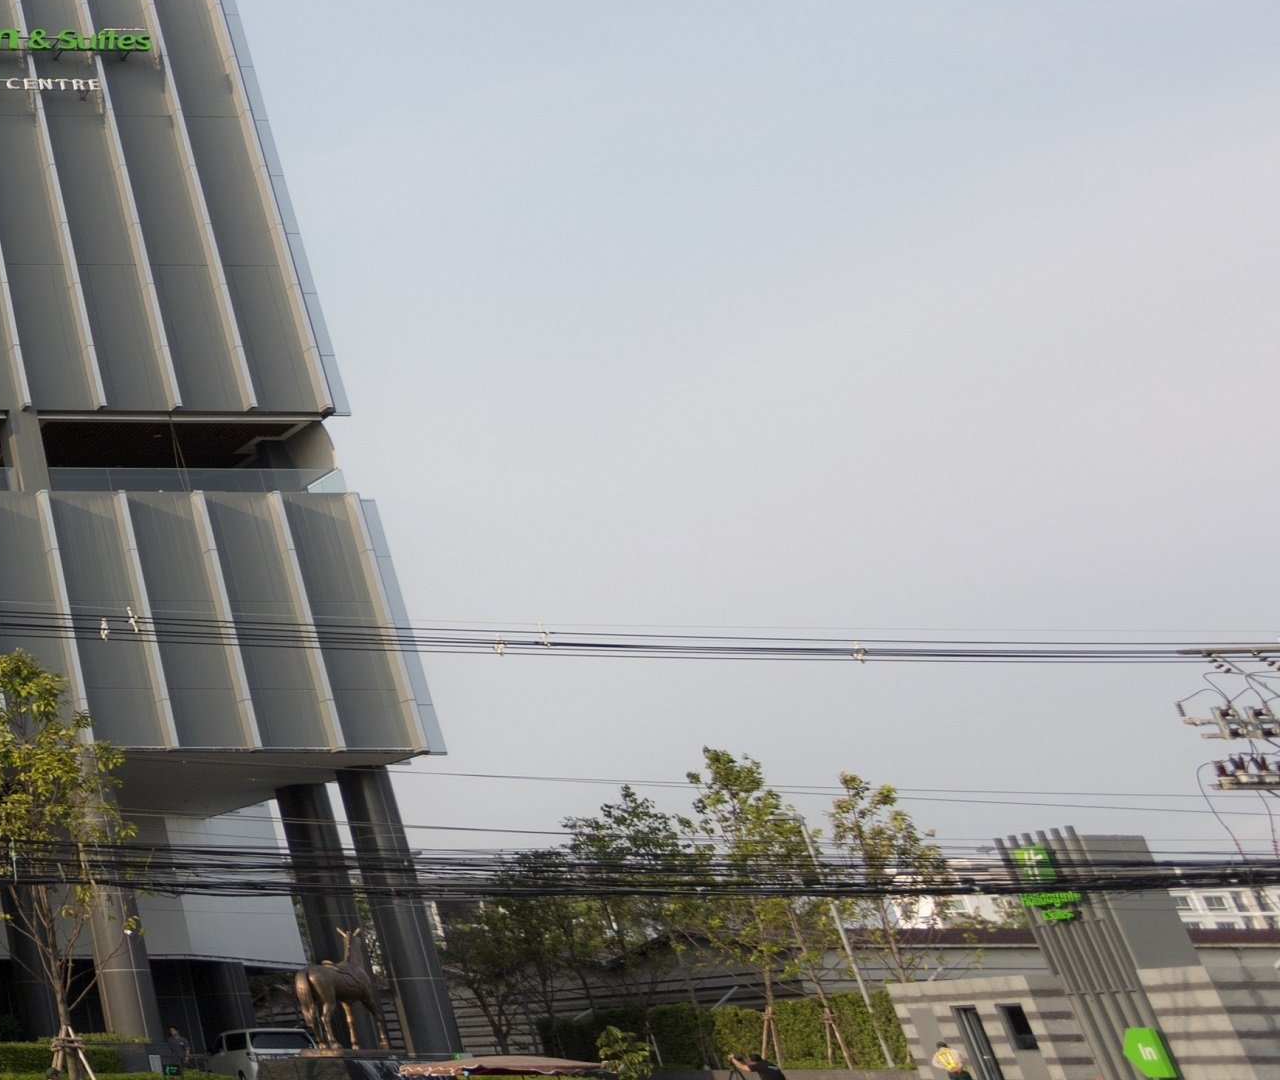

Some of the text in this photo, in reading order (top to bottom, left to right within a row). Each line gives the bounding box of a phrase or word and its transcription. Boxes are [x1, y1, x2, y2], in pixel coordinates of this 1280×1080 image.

[27, 29, 51, 50] &
[57, 29, 153, 52] Suites
[6, 77, 102, 91] CENTRE
